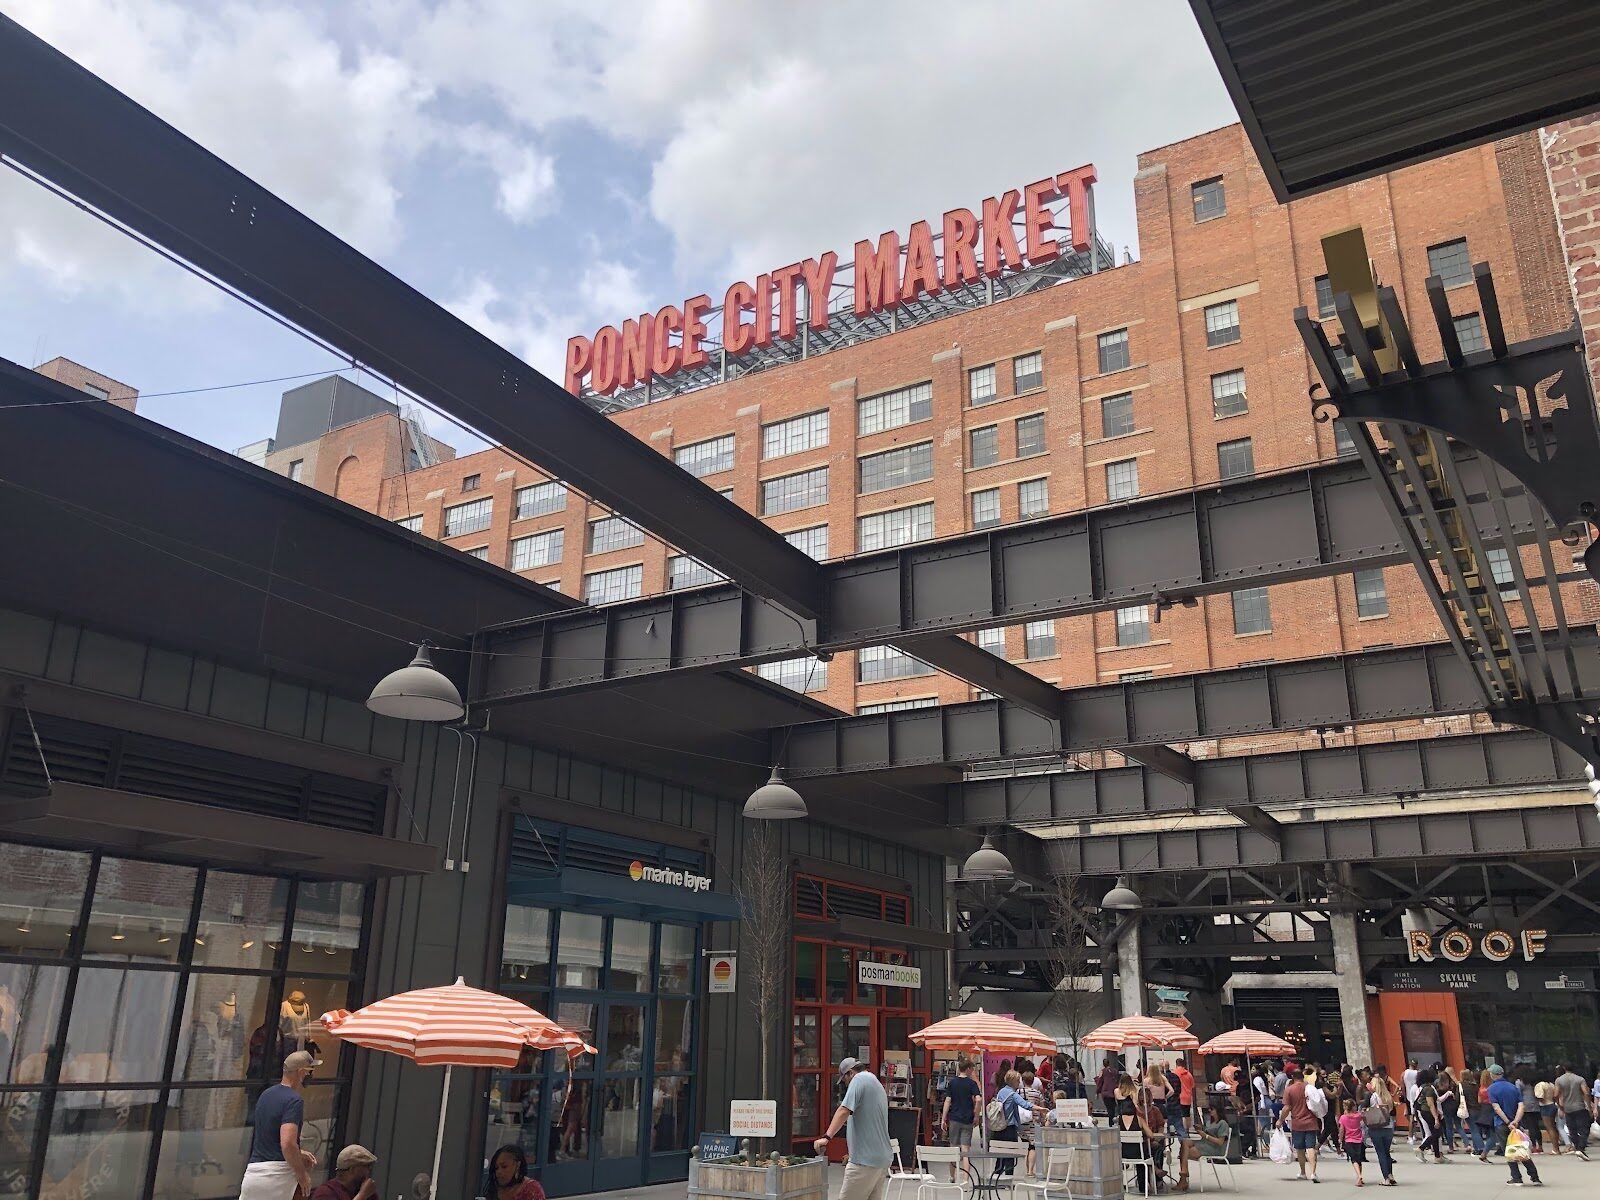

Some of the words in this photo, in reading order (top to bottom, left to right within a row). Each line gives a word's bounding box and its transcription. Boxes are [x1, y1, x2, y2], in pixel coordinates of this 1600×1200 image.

[565, 294, 712, 397] PONCE
[722, 251, 839, 356] CITY
[855, 163, 1098, 319] MARKET
[642, 866, 684, 886] marine
[683, 870, 712, 893] layer
[1468, 922, 1484, 930] THE
[1406, 928, 1548, 962] ROOF
[1440, 973, 1478, 983] SKYLINE
[1449, 981, 1470, 989] PARK
[733, 1121, 750, 1129] SOCIAL
[751, 1121, 773, 1129] DISTANCE
[703, 1144, 730, 1155] MARINE
